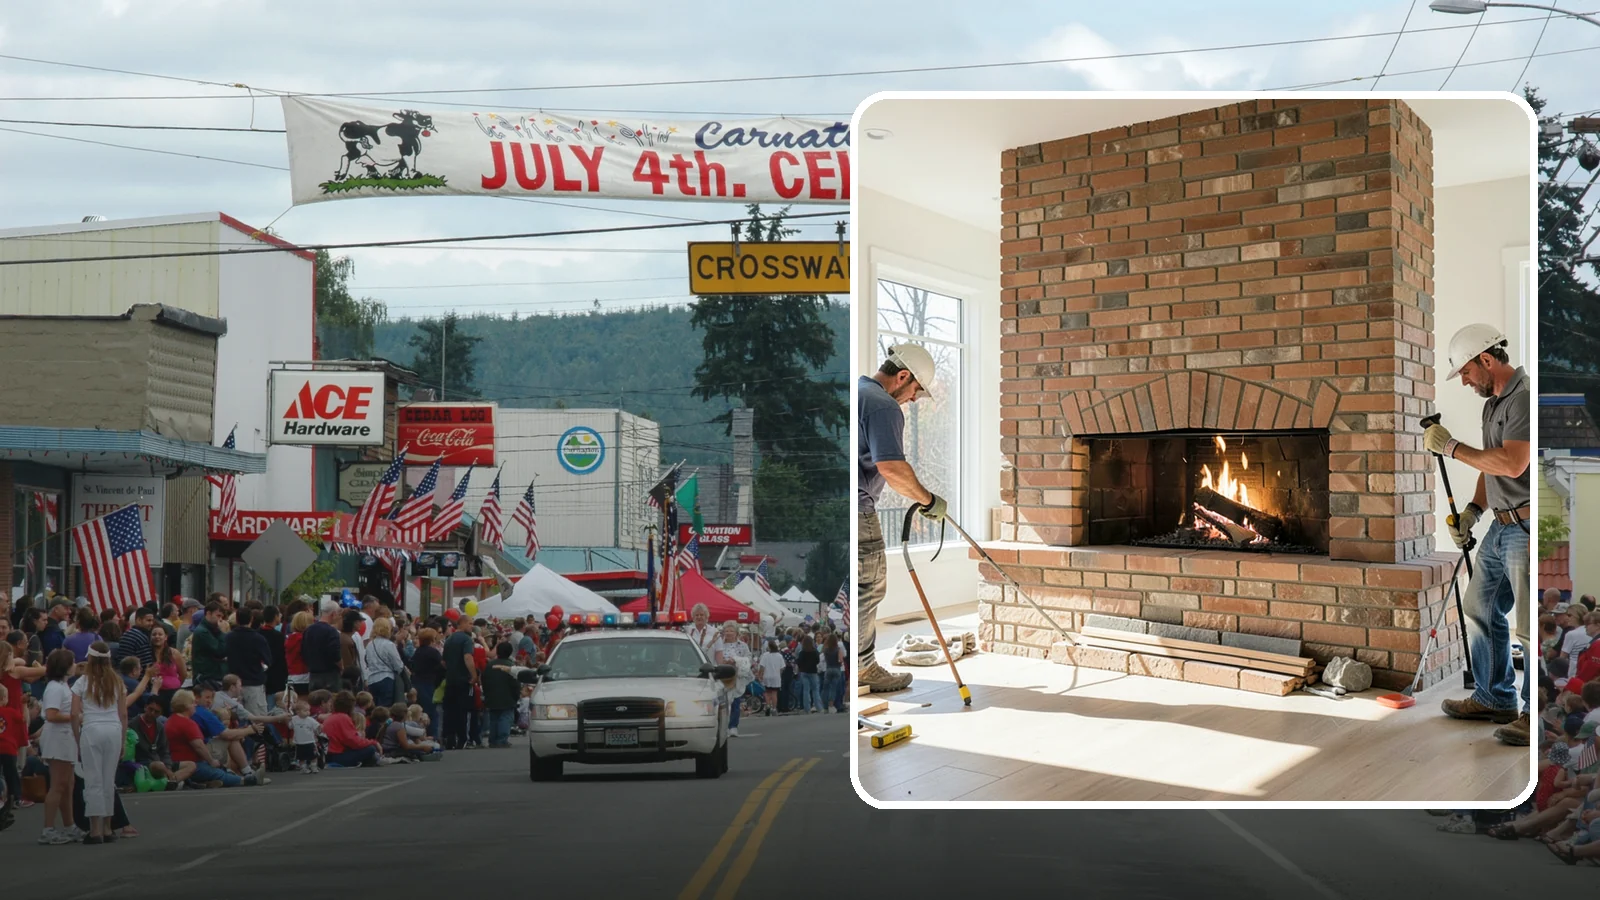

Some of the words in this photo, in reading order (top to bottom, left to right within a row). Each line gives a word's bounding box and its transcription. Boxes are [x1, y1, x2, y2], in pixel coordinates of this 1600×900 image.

[481, 141, 604, 192] JULY
[632, 150, 746, 197] 4th.
[697, 255, 849, 280] CROSSWA
[283, 380, 373, 420] ACE
[405, 409, 452, 421] CEDAR
[283, 421, 370, 436] Hardware
[416, 428, 477, 447] Coca-Cola
[353, 467, 384, 479] Simpl
[83, 485, 93, 493] St.
[95, 485, 125, 494] Vincent
[127, 486, 136, 494] de
[137, 486, 155, 495] Paul
[212, 515, 330, 535] HARDARE
[688, 526, 741, 535] CRNATION
[699, 535, 730, 543] GLASS
